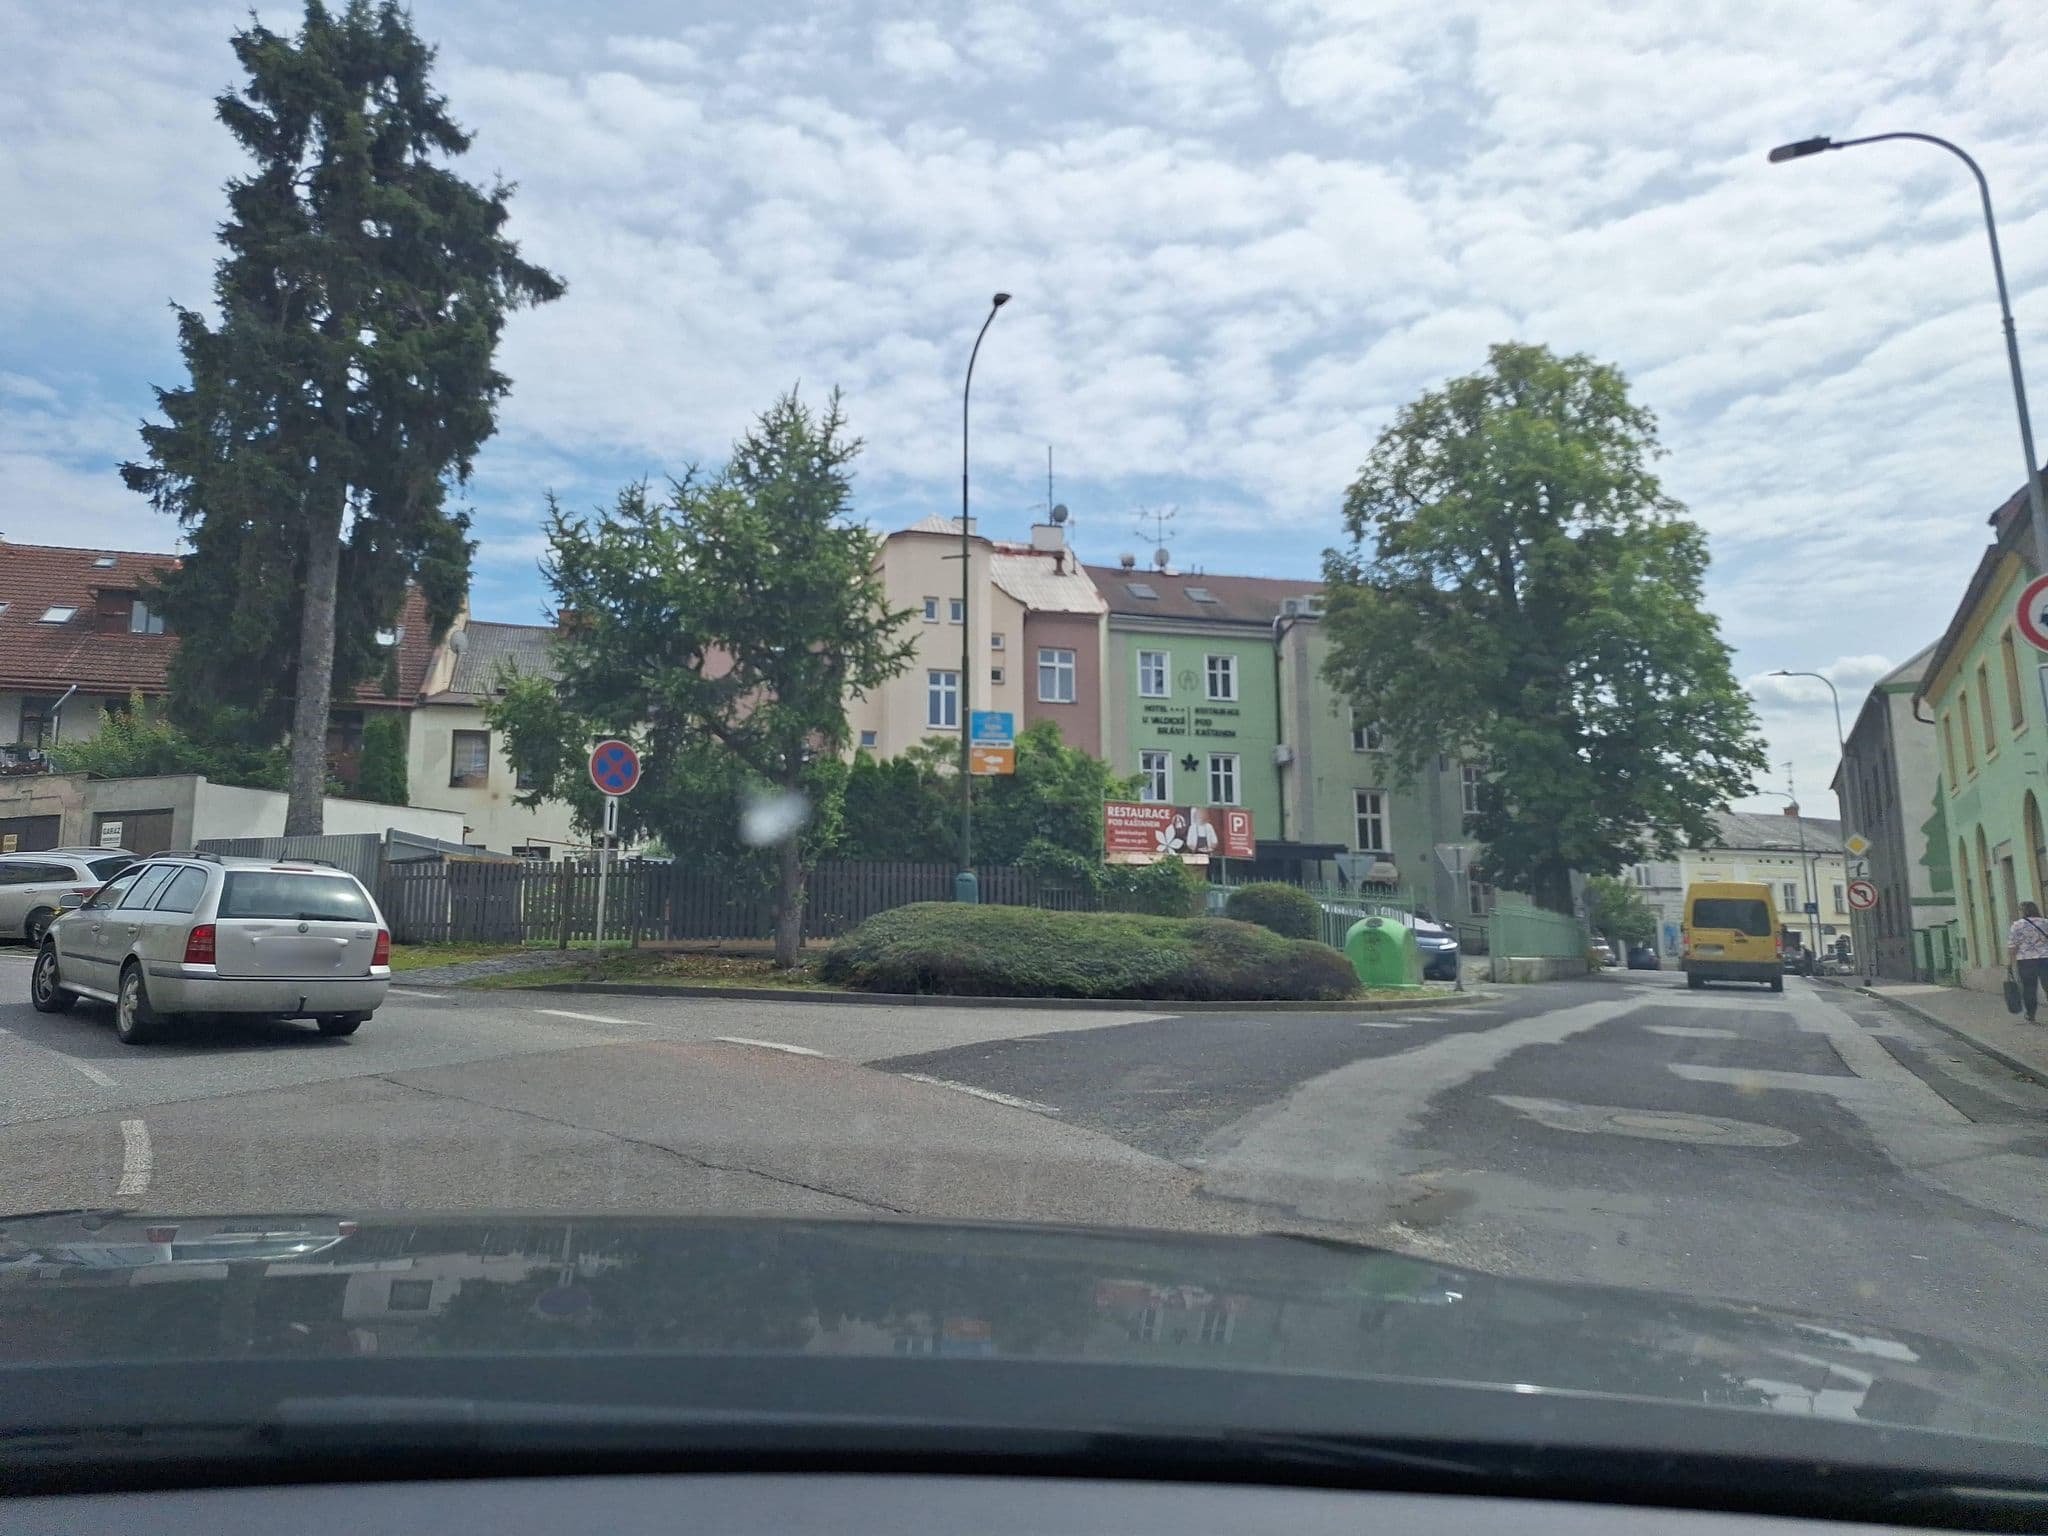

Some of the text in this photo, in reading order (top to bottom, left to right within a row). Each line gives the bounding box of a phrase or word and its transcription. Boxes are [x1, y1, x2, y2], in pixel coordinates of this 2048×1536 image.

[1144, 705, 1167, 713] HOTEL
[1195, 718, 1212, 727] POD
[1107, 806, 1170, 819] RESTAURACE
[1108, 818, 1123, 826] POD
[1233, 816, 1244, 832] P
